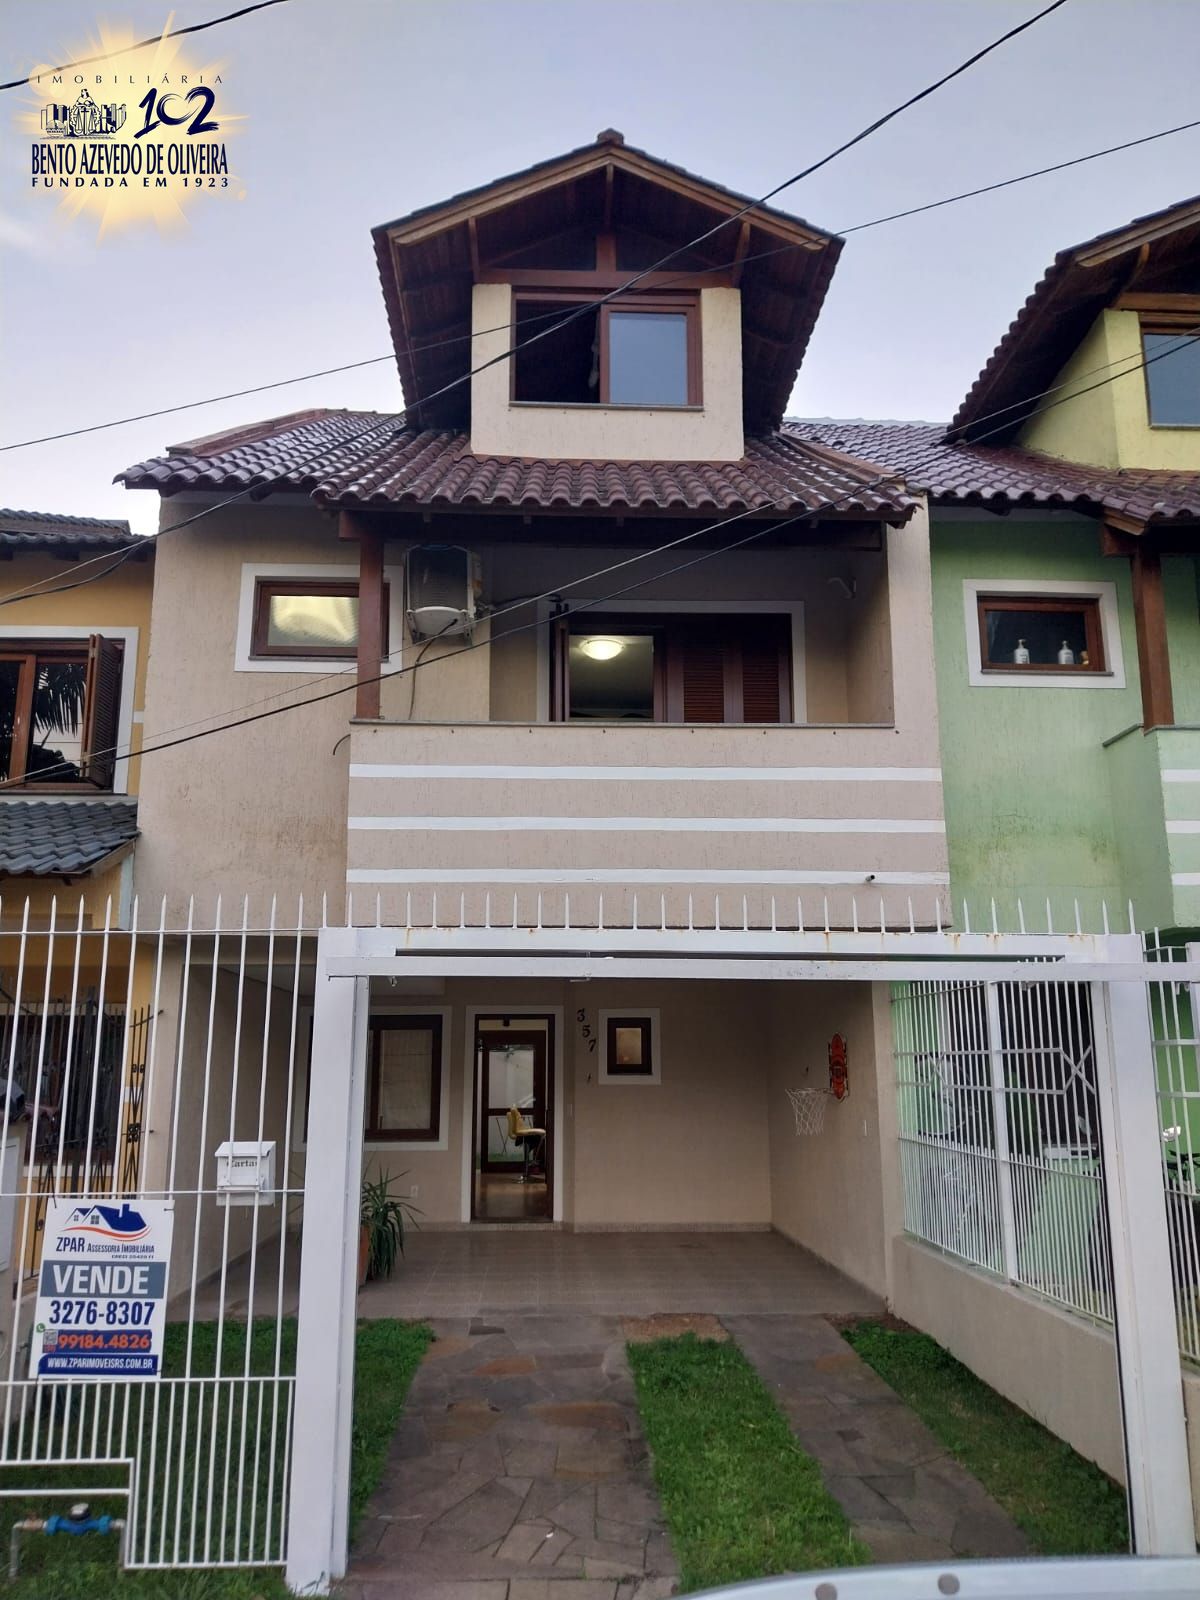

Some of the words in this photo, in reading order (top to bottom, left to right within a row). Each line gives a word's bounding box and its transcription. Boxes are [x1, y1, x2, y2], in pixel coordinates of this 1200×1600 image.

[56, 1236, 86, 1253] ZPAR
[53, 1264, 150, 1295] VENDE
[49, 1300, 155, 1326] 3276-8307
[58, 1333, 150, 1349] 99184.4826
[47, 1357, 153, 1369] WWW.ZPARIMOVEISRS.COM.BR
